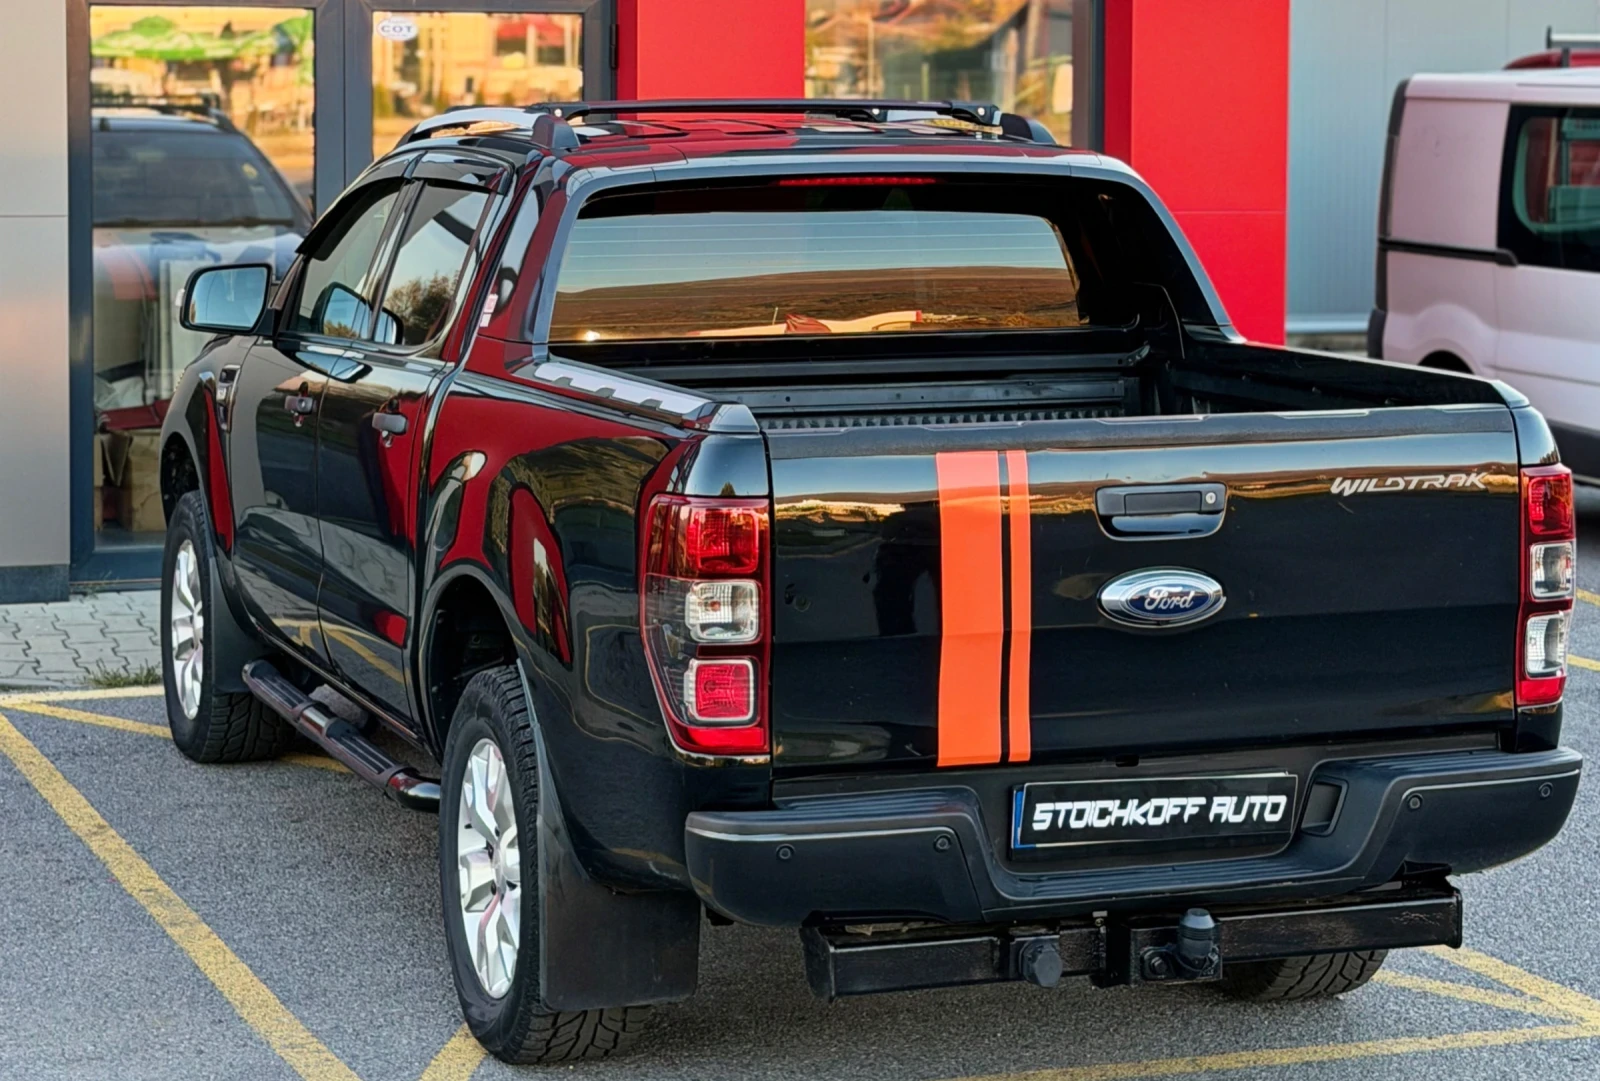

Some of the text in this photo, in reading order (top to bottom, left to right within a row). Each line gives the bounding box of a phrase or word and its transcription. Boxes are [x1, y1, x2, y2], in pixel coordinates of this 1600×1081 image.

[1330, 472, 1488, 496] WILDTRAK
[1144, 586, 1195, 610] Ford
[1032, 795, 1288, 831] STOICHKOFF AUTO
